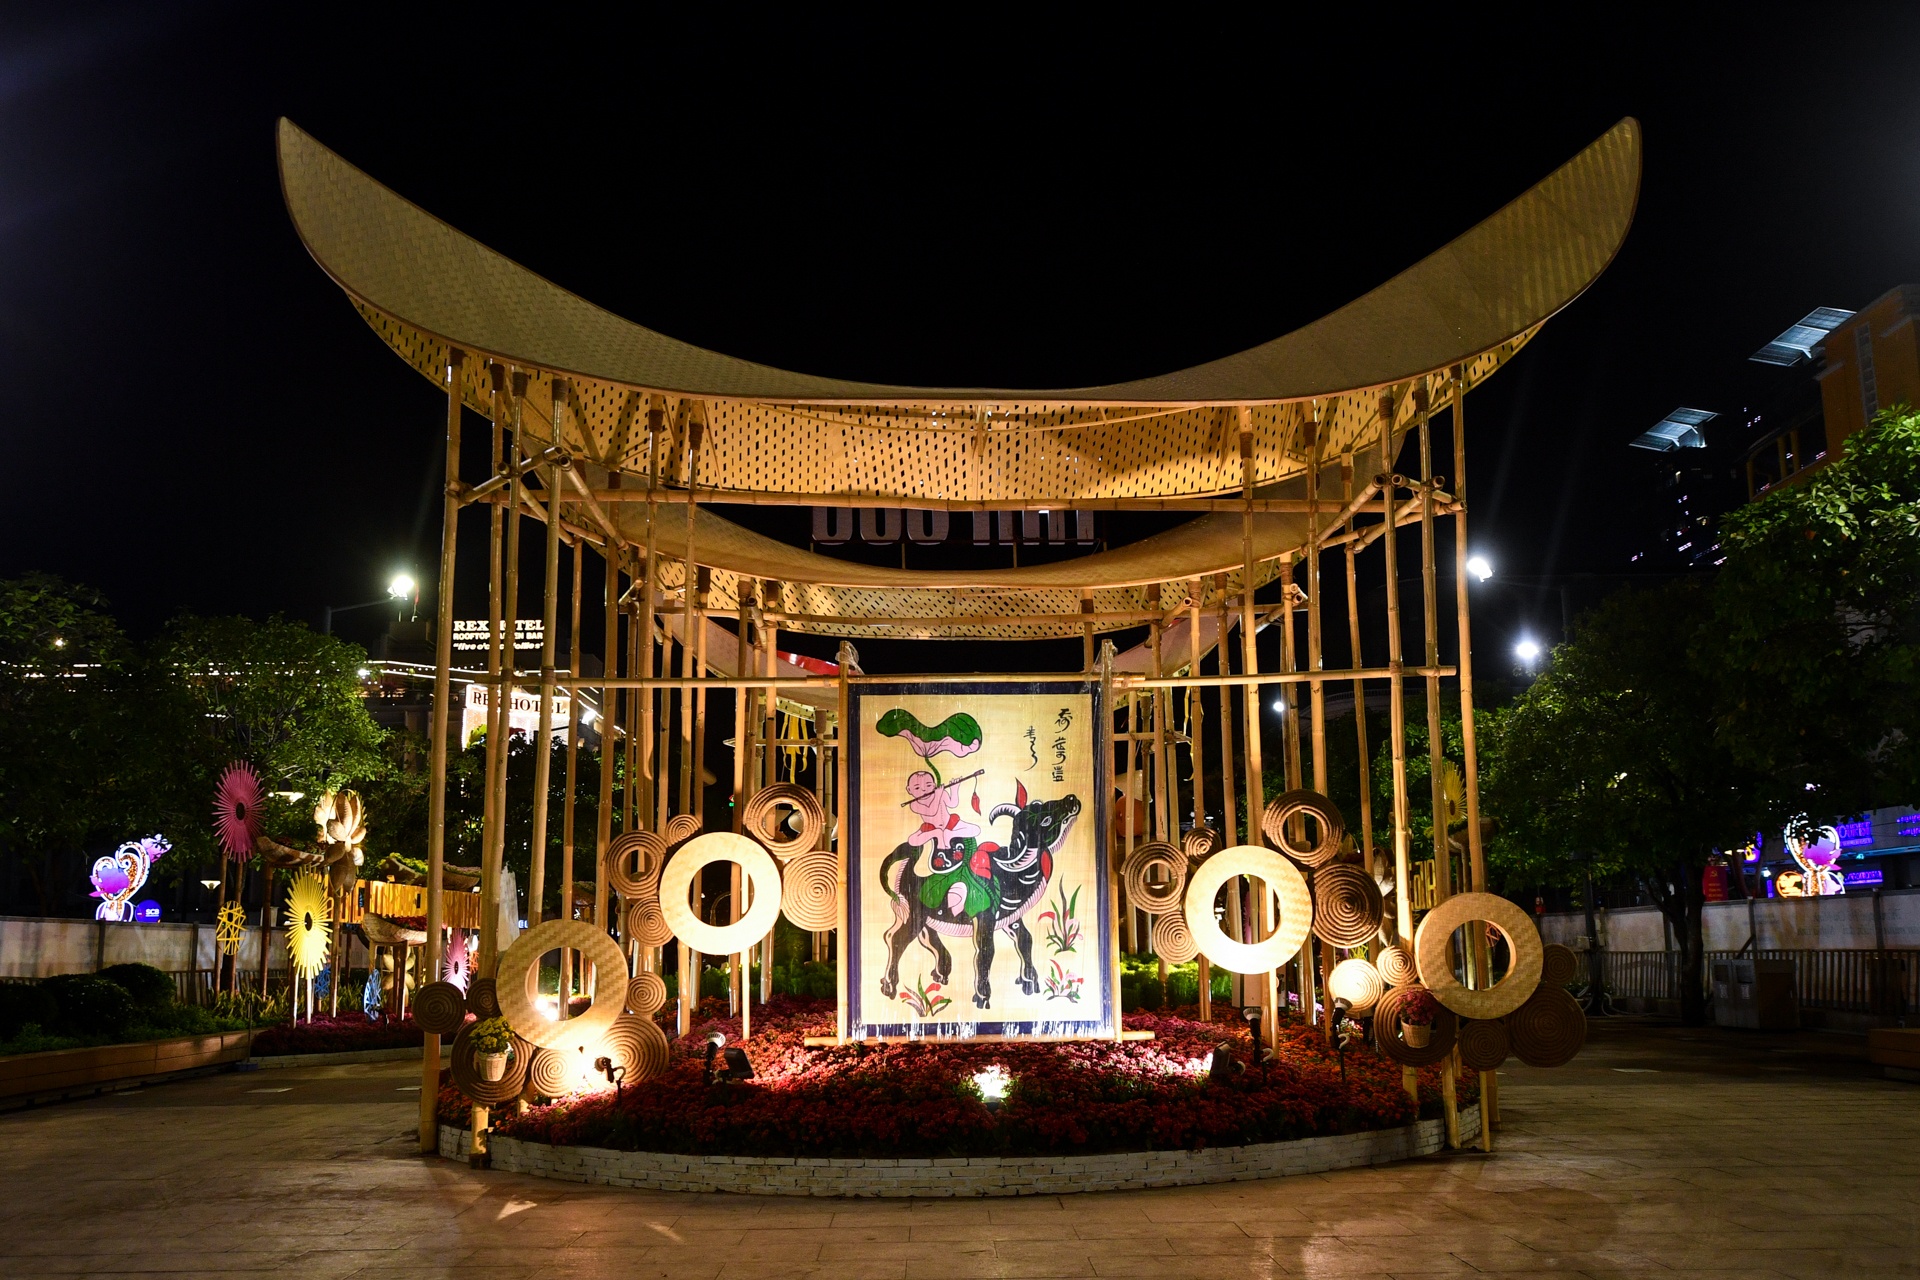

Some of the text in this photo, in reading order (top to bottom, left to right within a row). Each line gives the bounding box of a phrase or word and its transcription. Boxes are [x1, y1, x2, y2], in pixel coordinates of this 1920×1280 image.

[453, 620, 489, 632] REX
[452, 632, 491, 641] ROOFTOP
[526, 632, 543, 640] BAR
[510, 698, 565, 715] HOTL
